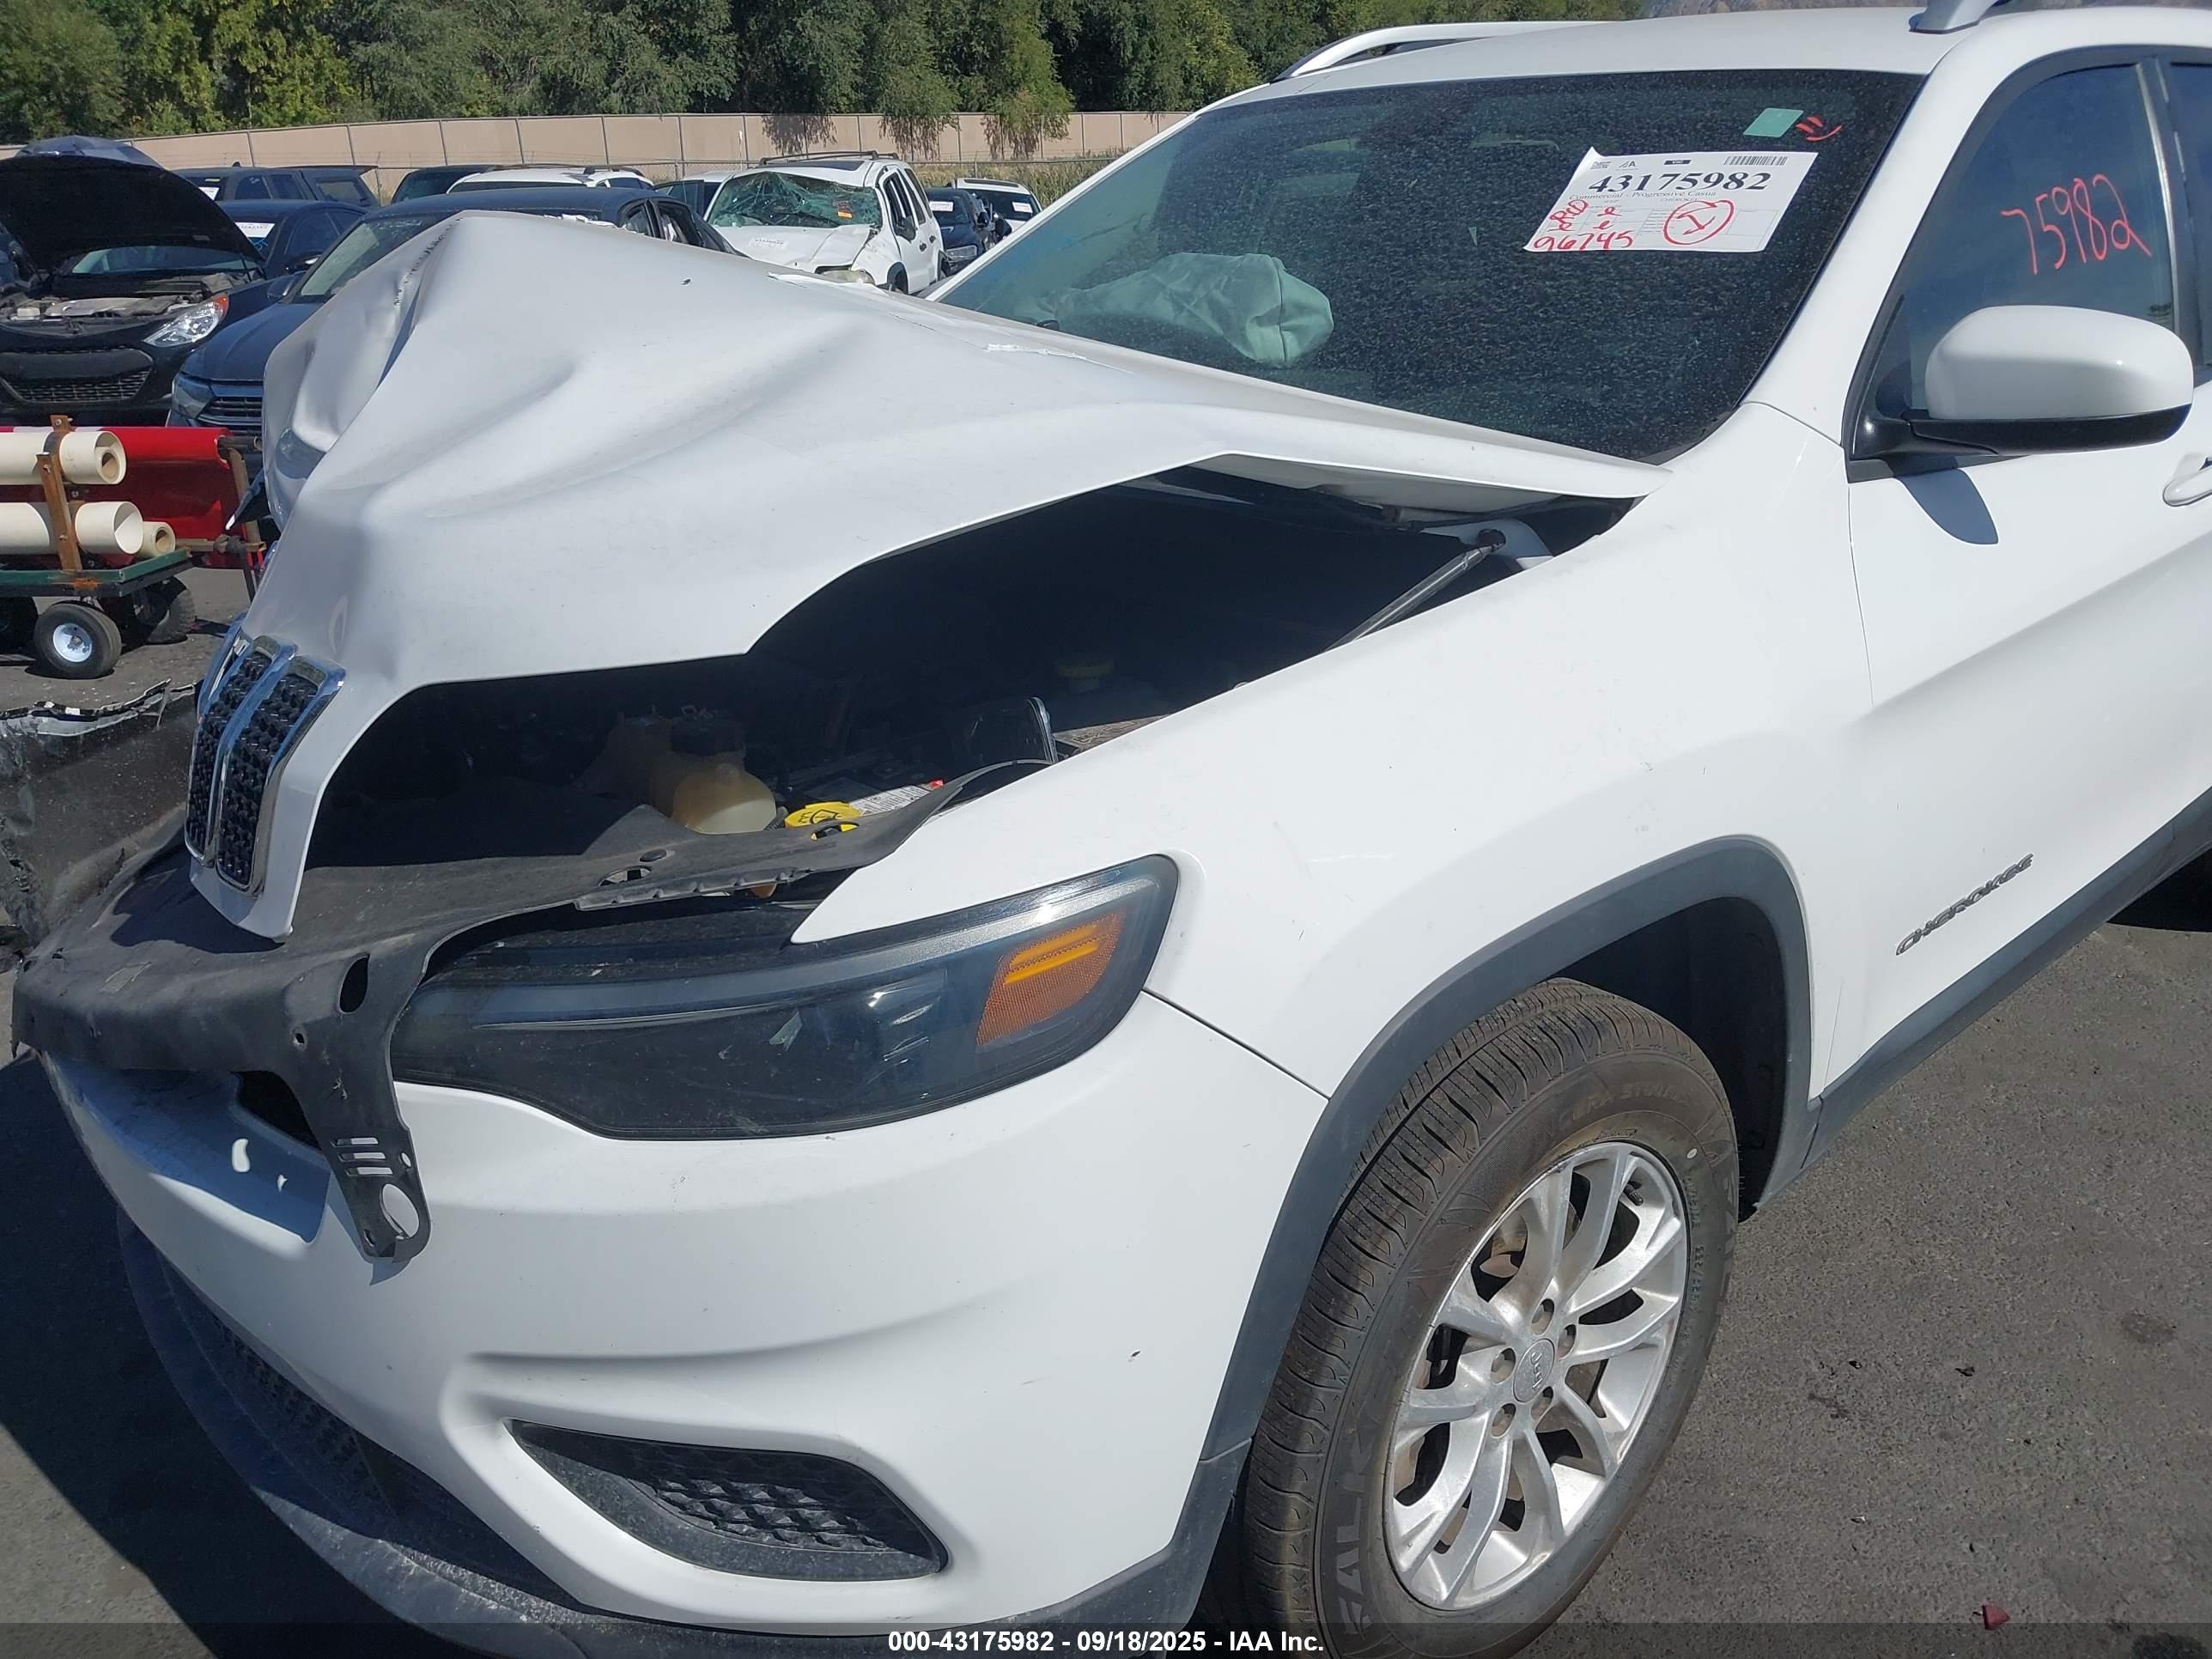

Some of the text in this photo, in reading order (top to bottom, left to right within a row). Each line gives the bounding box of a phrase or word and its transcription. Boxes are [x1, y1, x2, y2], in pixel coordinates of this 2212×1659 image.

[1589, 172, 1771, 192] 43175982
[2001, 174, 2152, 275] 75982
[1533, 230, 1634, 252] 96745
